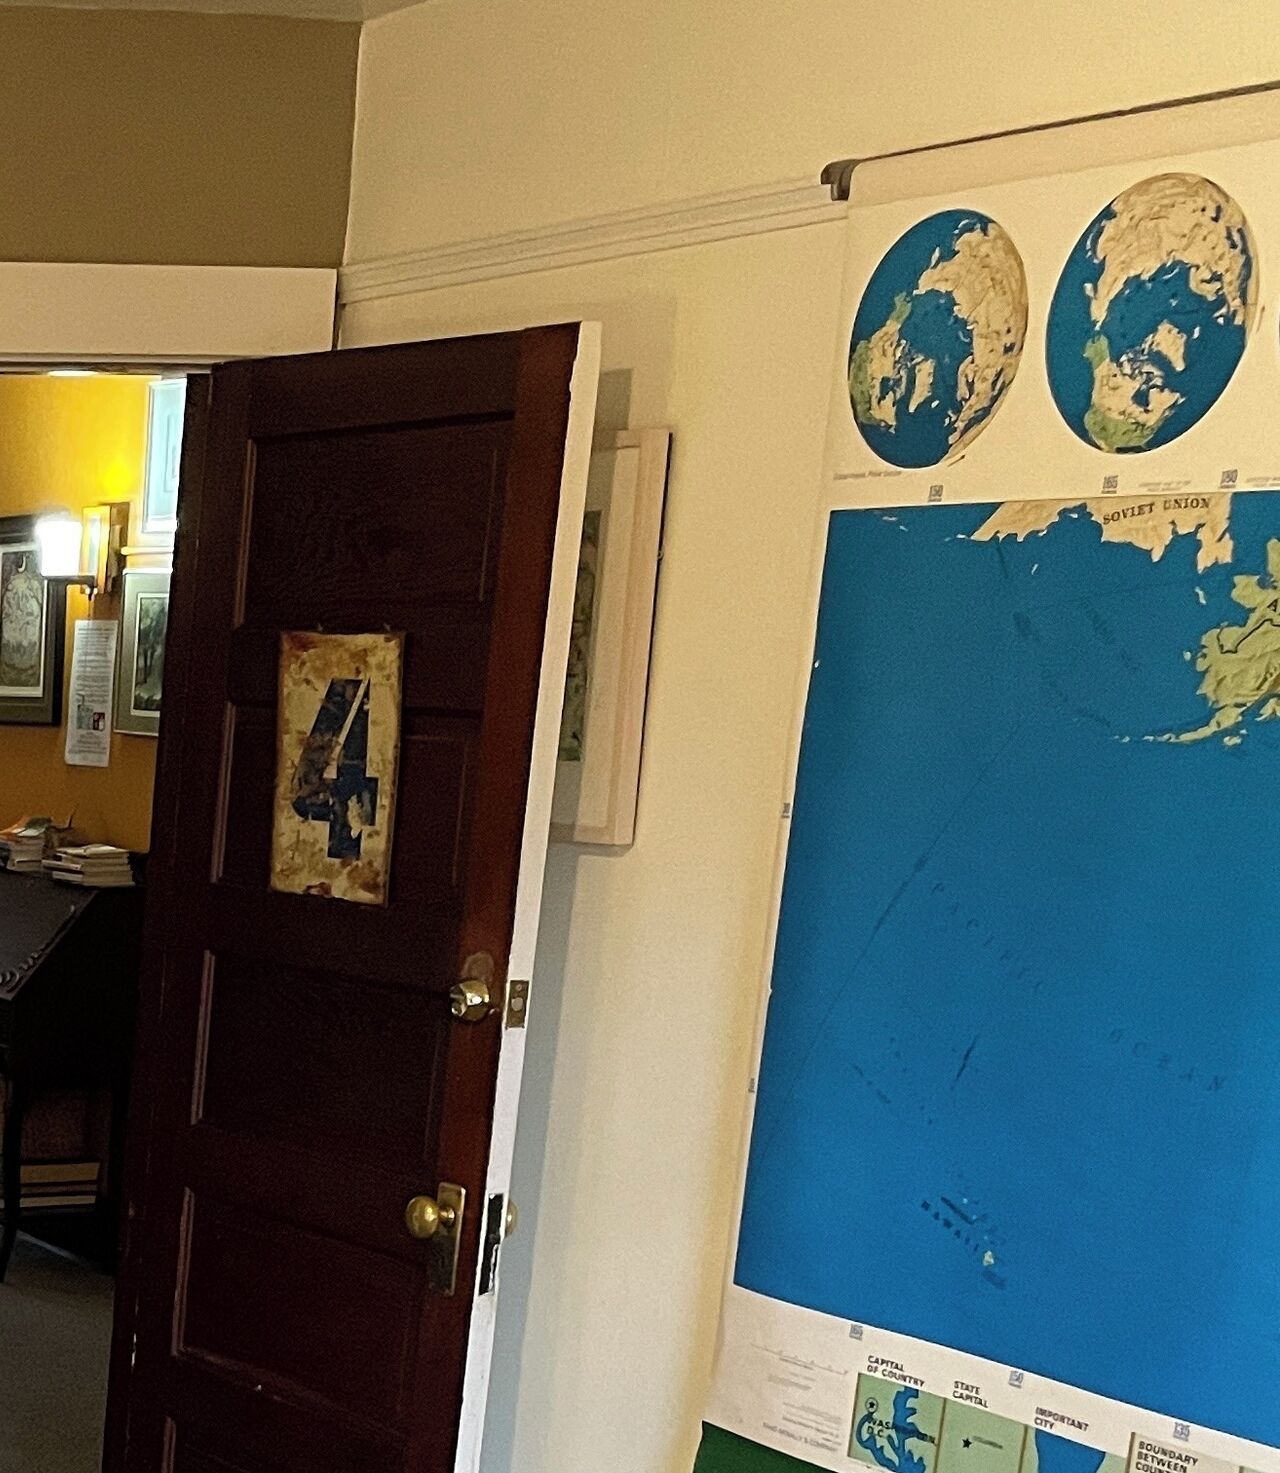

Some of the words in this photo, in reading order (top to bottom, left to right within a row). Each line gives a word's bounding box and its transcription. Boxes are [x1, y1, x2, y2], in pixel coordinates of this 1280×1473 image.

[1102, 502, 1155, 525] SOVIET
[1163, 497, 1211, 512] UNION
[292, 678, 379, 860] 4
[867, 1355, 905, 1372] CAPITAL
[866, 1365, 878, 1374] OF
[881, 1368, 925, 1387] COUNTRY
[953, 1380, 981, 1395] STATE
[952, 1390, 989, 1409] CAPITAL
[1034, 1417, 1055, 1430] CITY
[1035, 1406, 1090, 1431] IMPORTANT
[1137, 1450, 1188, 1473] BETWEEN
[1138, 1440, 1199, 1467] BOUNDARY
